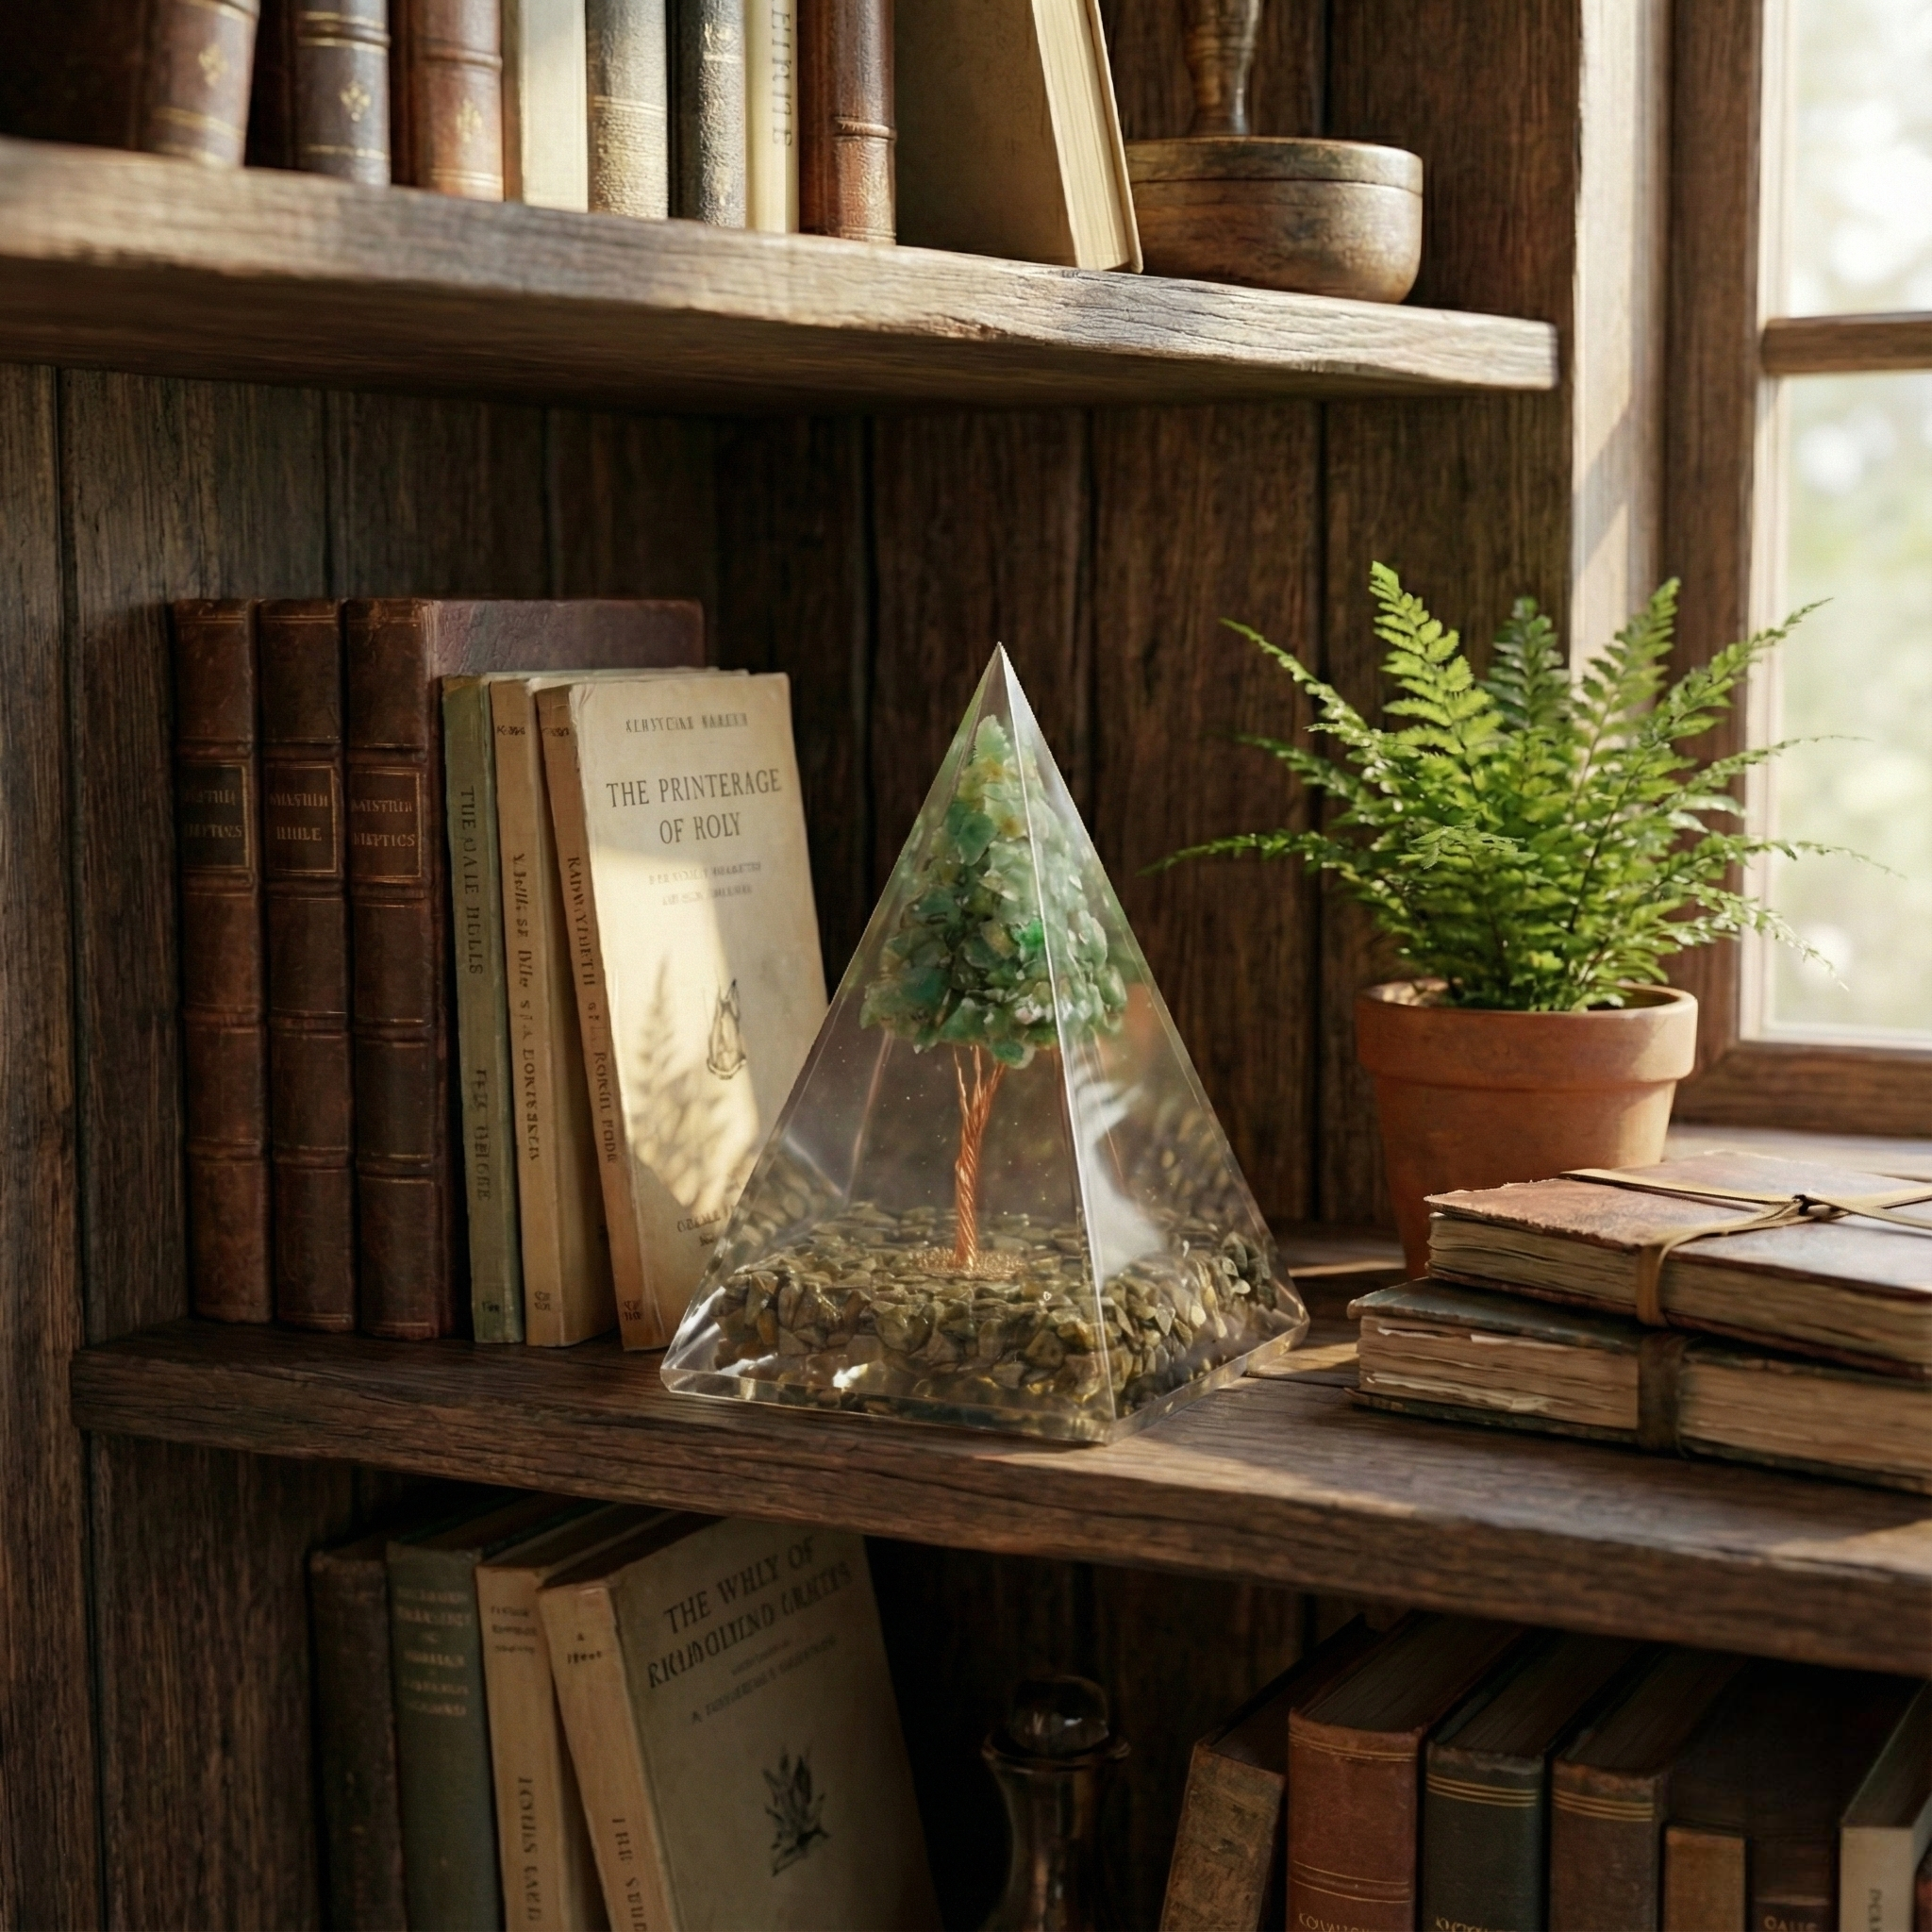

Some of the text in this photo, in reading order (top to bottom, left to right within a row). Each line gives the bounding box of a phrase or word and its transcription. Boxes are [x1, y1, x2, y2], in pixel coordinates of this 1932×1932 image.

[606, 768, 782, 808] THE PRINTERAGE
[658, 818, 685, 844] OF
[663, 1590, 711, 1635] THE
[788, 1536, 815, 1569] OF
